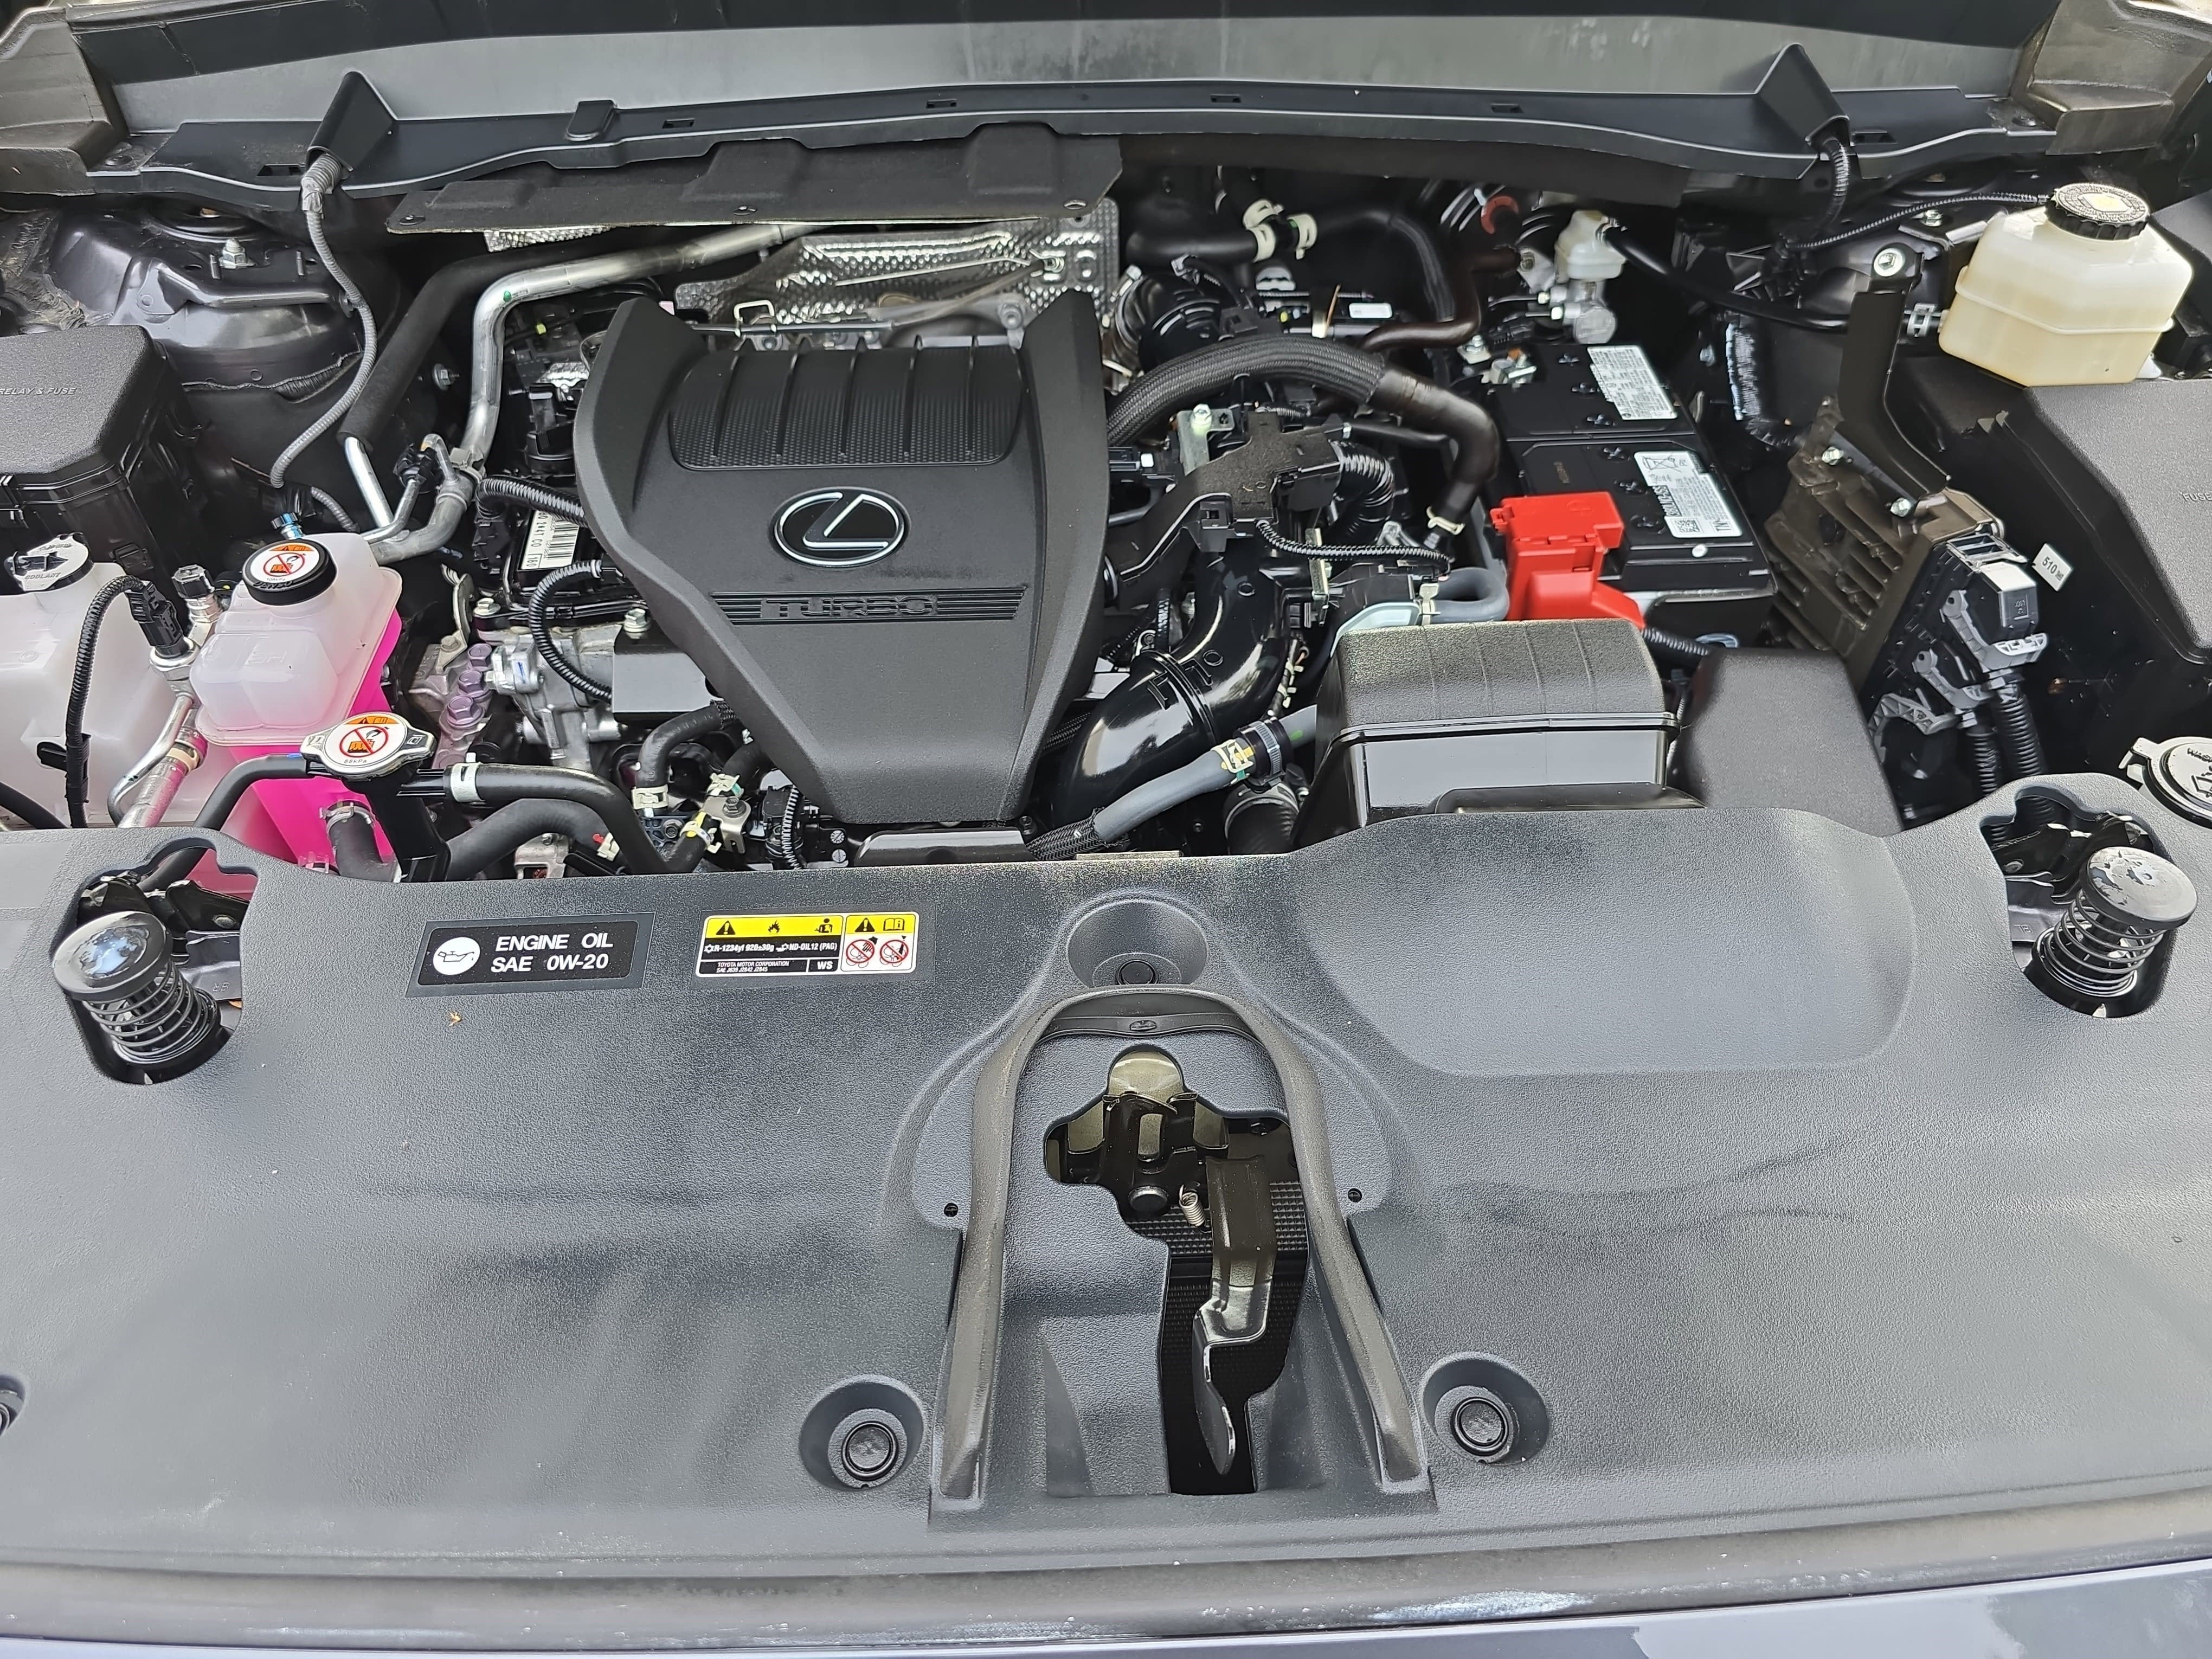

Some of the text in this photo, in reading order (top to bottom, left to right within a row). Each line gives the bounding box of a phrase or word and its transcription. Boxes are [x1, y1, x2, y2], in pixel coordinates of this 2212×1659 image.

[526, 556, 538, 567] 180
[2042, 556, 2057, 574] 510
[765, 596, 933, 617] TURBO
[495, 933, 614, 952] ENGINE OIL
[820, 942, 838, 951] (PAG)
[491, 953, 609, 973] SAE 0W-20
[817, 961, 833, 970] WS
